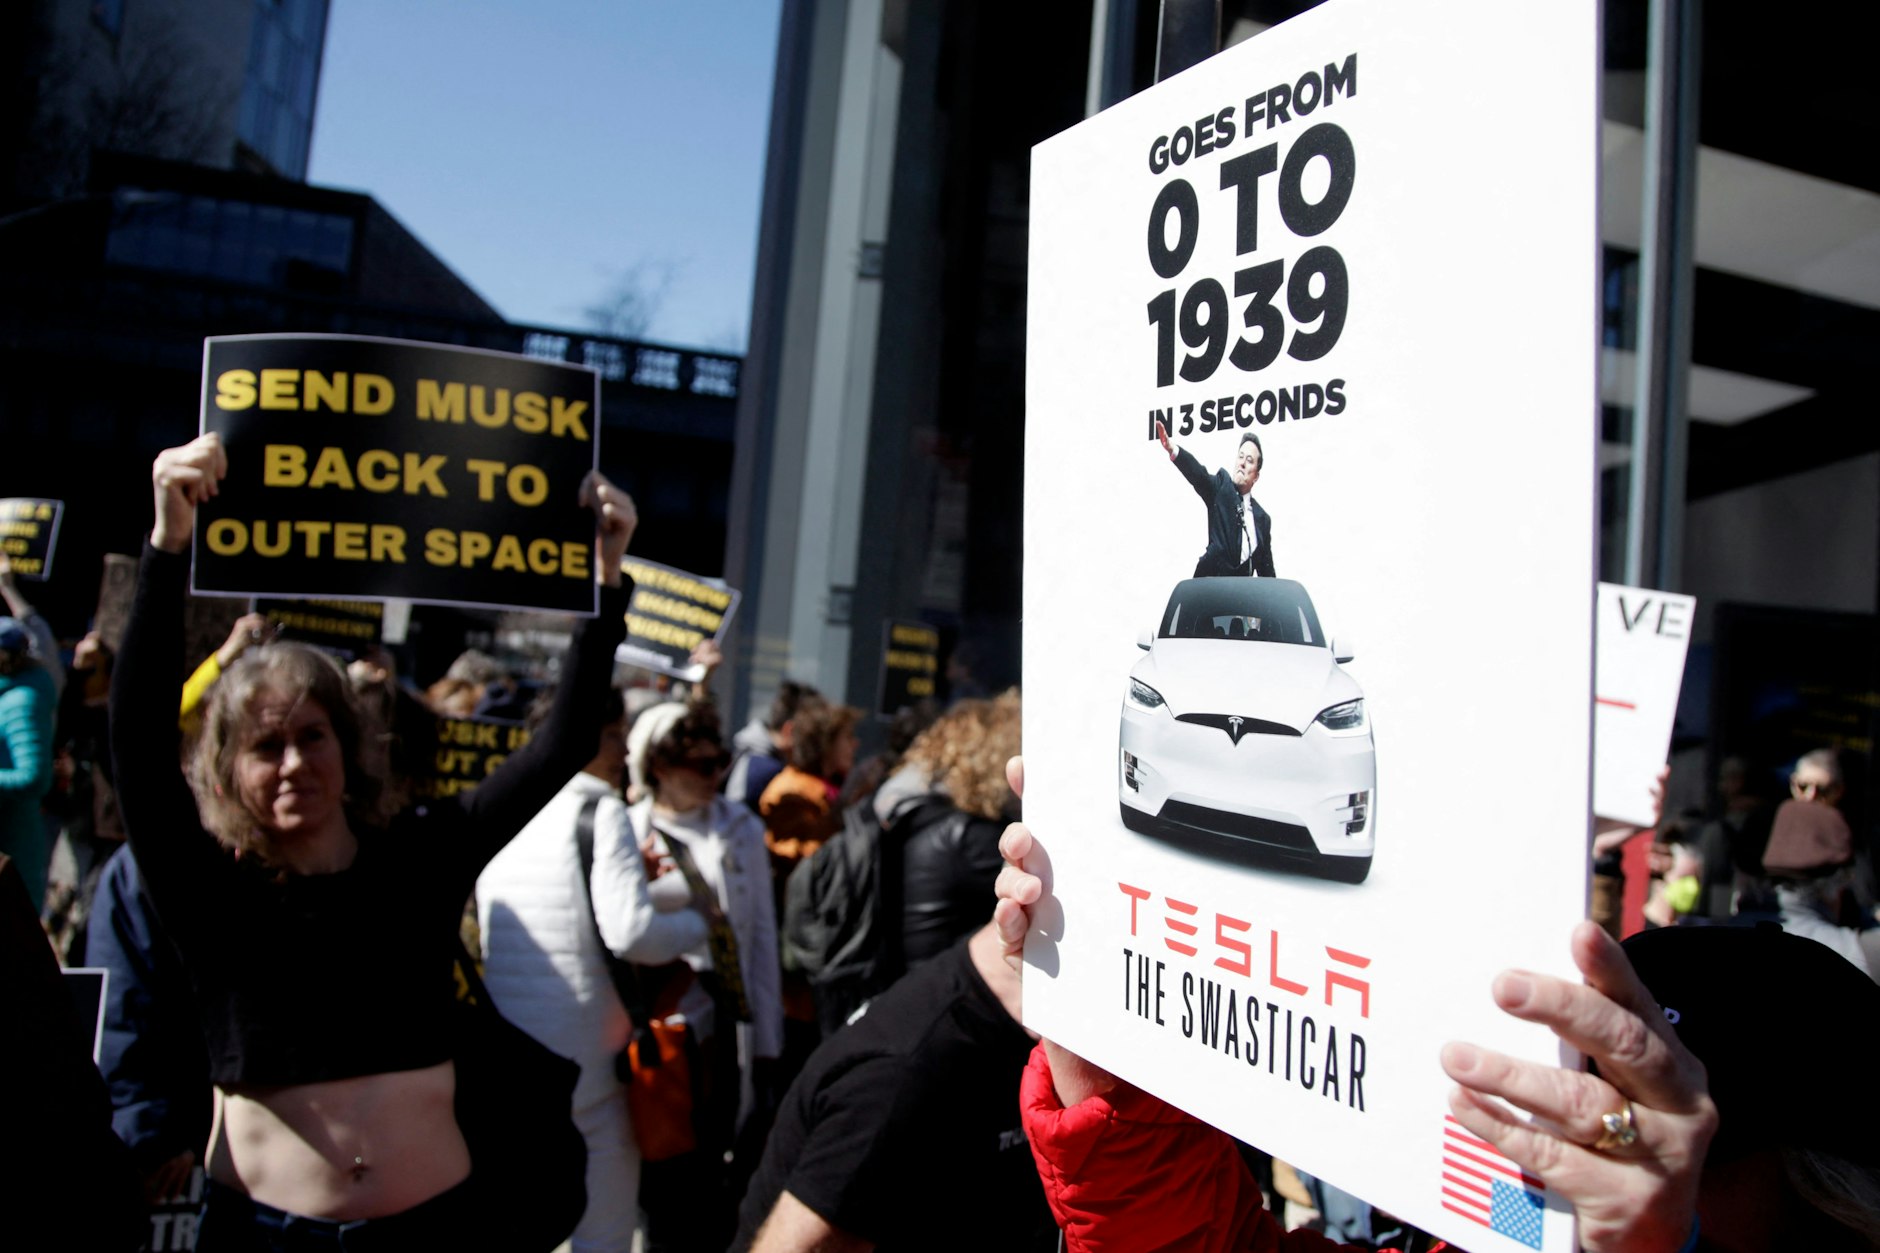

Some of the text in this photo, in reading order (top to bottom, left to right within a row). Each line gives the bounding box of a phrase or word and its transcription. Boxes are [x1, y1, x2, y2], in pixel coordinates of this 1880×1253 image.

[1149, 52, 1357, 175] GOES FROM
[1220, 122, 1356, 256] TO
[1147, 245, 1349, 388] 1939
[215, 368, 591, 442] SEND MUSK
[1149, 378, 1346, 440] IN 3 SECONDS
[263, 443, 550, 509] BACK TO
[205, 517, 591, 580] OUTER SPACE
[434, 719, 499, 751] USK
[434, 748, 479, 777] UT
[1118, 882, 1372, 1019] TESLA
[1123, 948, 1366, 1113] THE SWASTICAR
